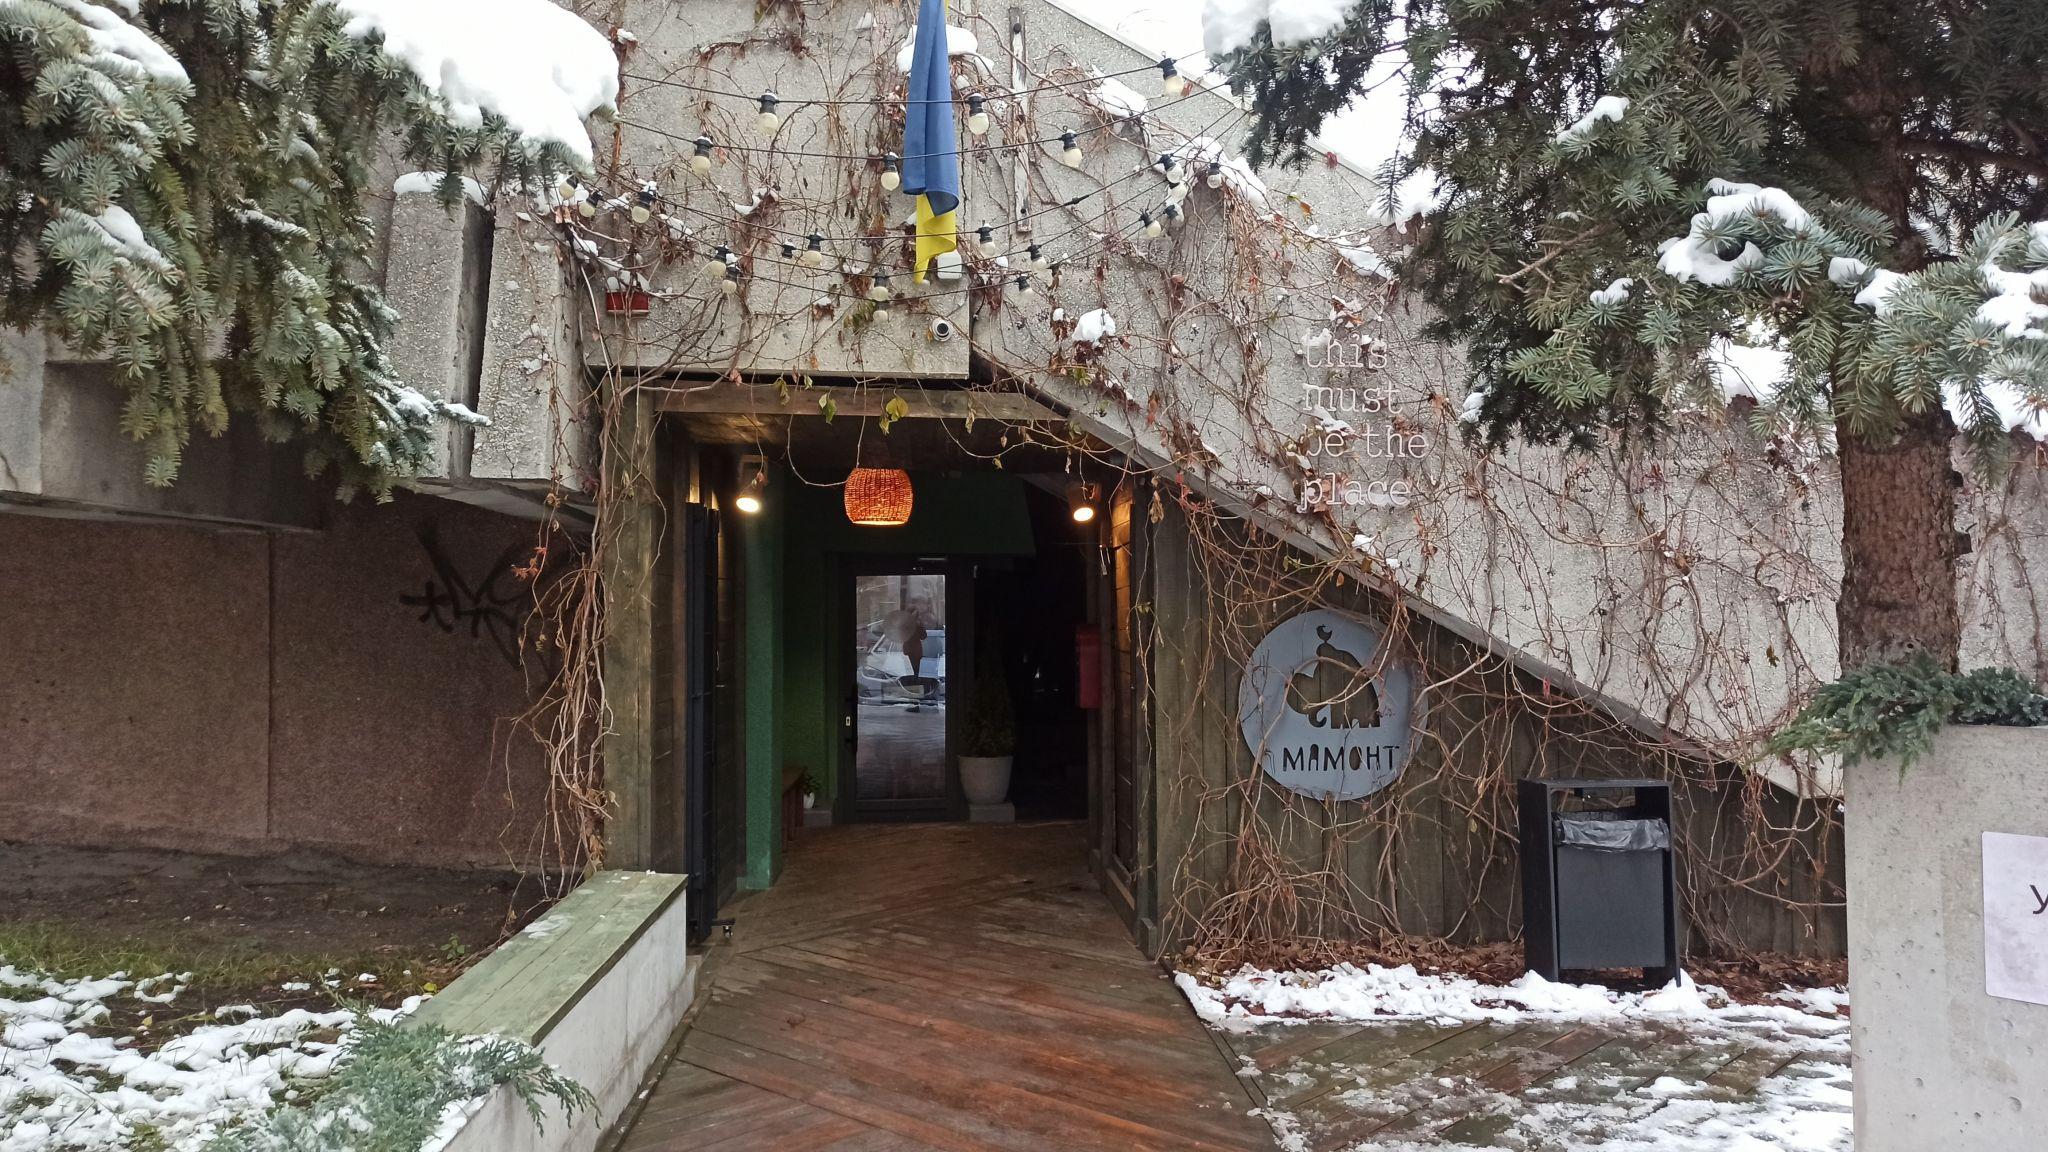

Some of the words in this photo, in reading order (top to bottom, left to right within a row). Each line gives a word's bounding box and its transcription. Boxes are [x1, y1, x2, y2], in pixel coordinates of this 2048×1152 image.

[1305, 330, 1388, 369] this
[1302, 381, 1403, 414] must
[1362, 424, 1429, 459] the
[1297, 473, 1412, 513] place
[1282, 744, 1400, 772] МАМОНТ
